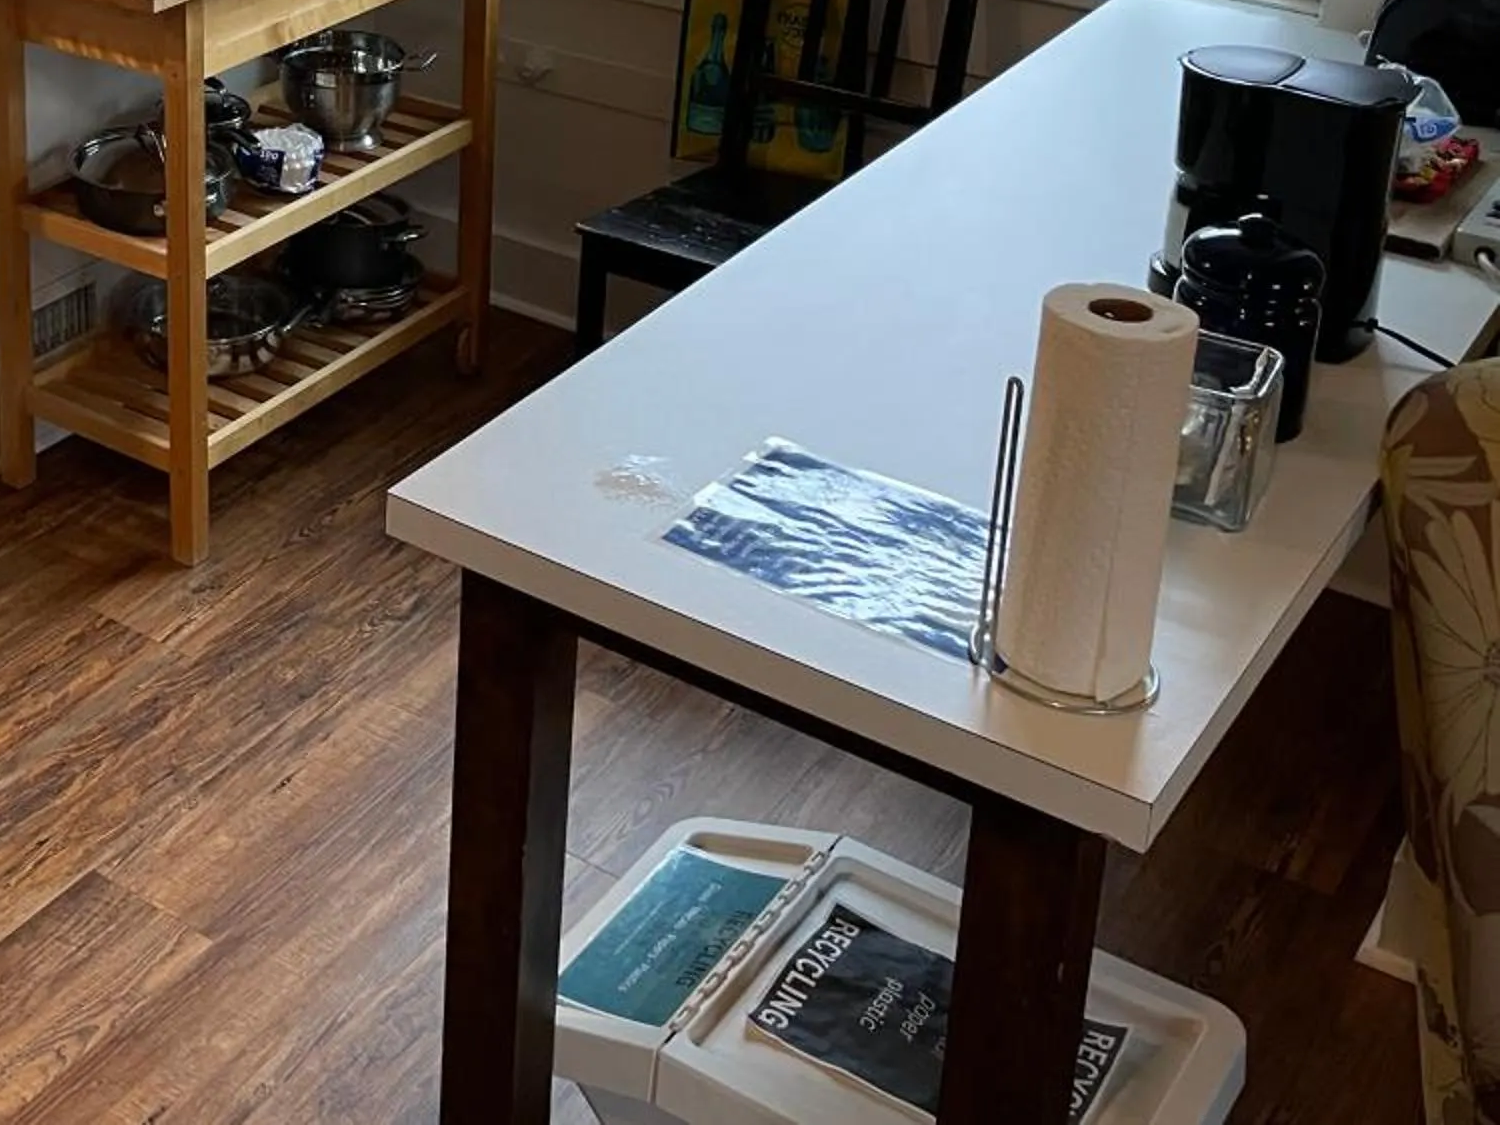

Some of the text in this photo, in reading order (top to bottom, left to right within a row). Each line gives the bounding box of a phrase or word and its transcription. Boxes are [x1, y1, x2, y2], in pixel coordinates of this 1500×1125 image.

[675, 908, 756, 989] RECYCLING
[757, 917, 861, 1030] RECYCLING
[859, 976, 904, 1032] plastic
[899, 991, 936, 1043] paper
[1069, 1029, 1117, 1117] RECYC
